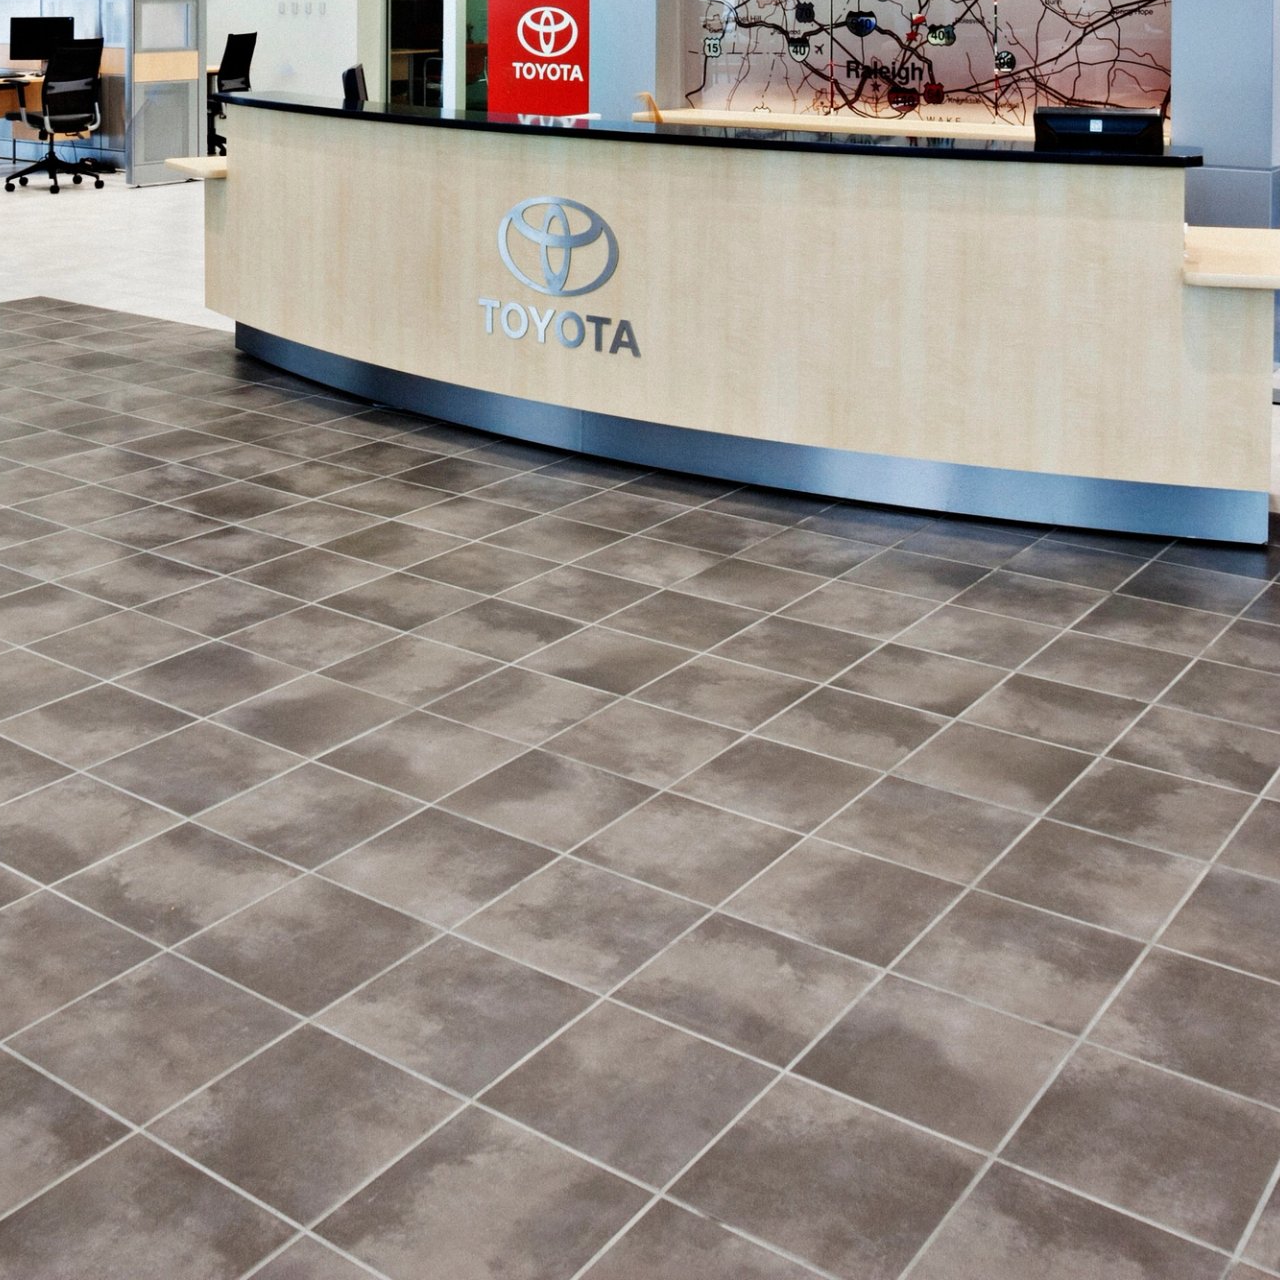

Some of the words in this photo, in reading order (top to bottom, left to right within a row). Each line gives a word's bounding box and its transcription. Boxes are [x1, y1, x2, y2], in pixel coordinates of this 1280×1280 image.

[931, 30, 953, 41] 401
[706, 43, 718, 53] 15
[792, 47, 806, 56] 40
[512, 62, 584, 82] TOYOTA
[846, 61, 923, 84] Raleigh
[478, 297, 641, 358] TOYOTA
